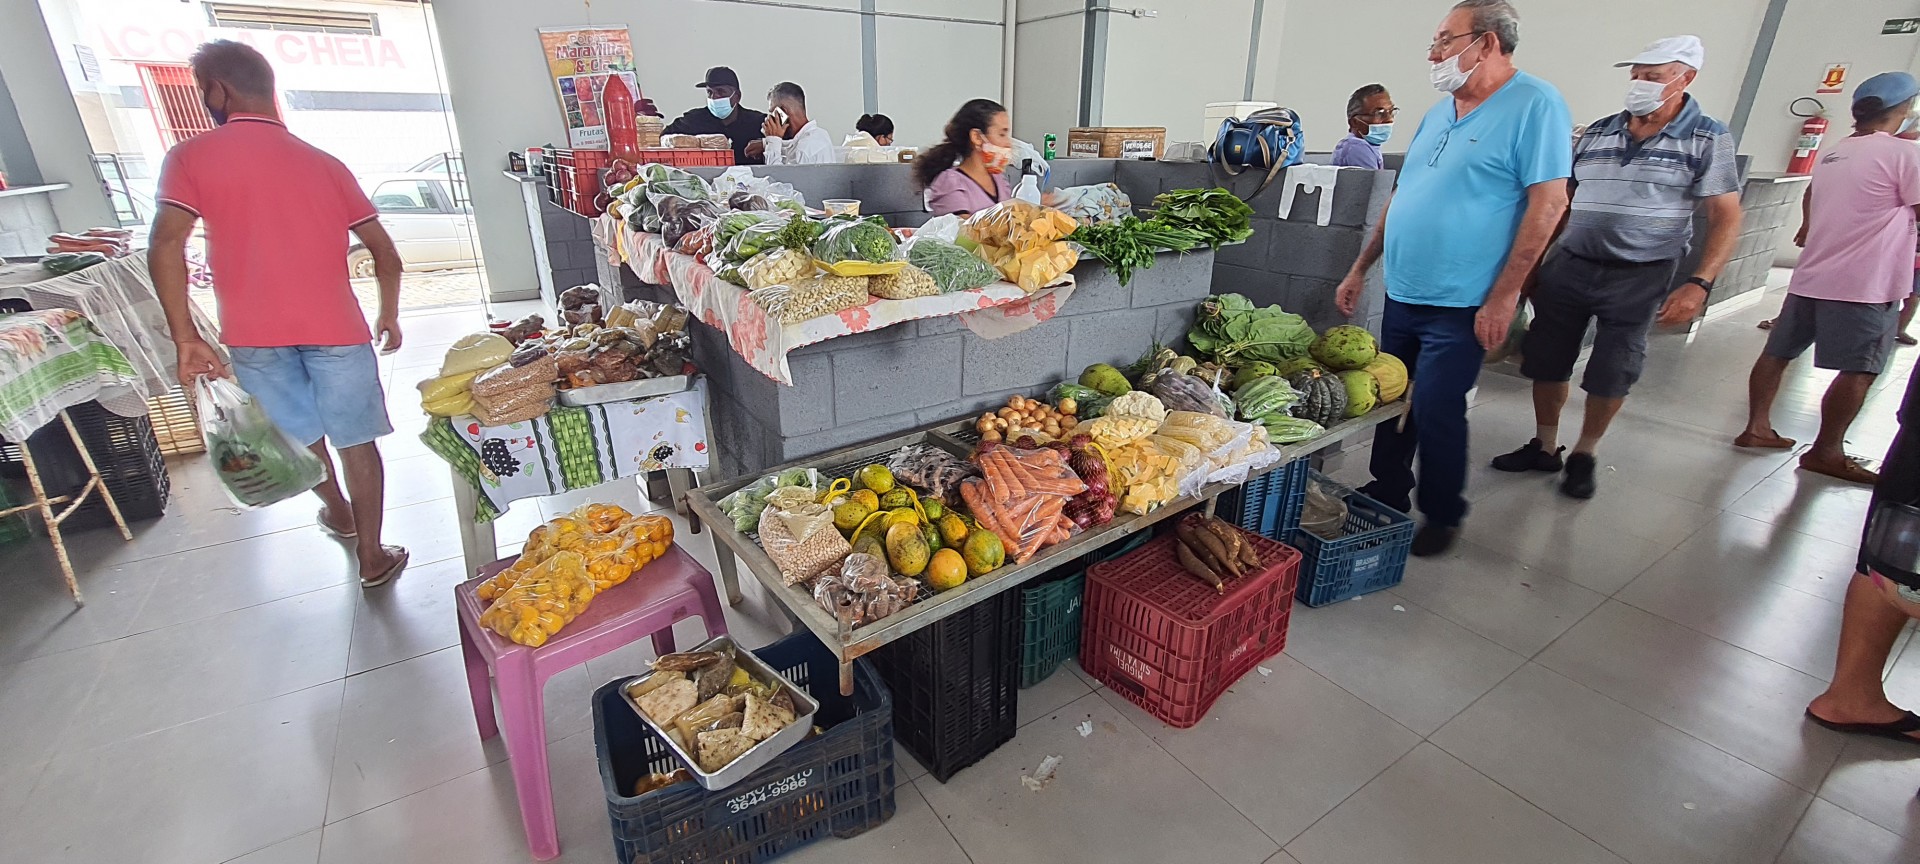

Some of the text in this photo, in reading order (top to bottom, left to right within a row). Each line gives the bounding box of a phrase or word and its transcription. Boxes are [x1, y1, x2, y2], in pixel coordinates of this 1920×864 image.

[275, 33, 406, 69] CHEIA
[575, 59, 586, 73] &
[579, 128, 605, 137] Frutas
[1115, 656, 1144, 681] MIGUEL
[730, 777, 807, 814] 3644-9986
